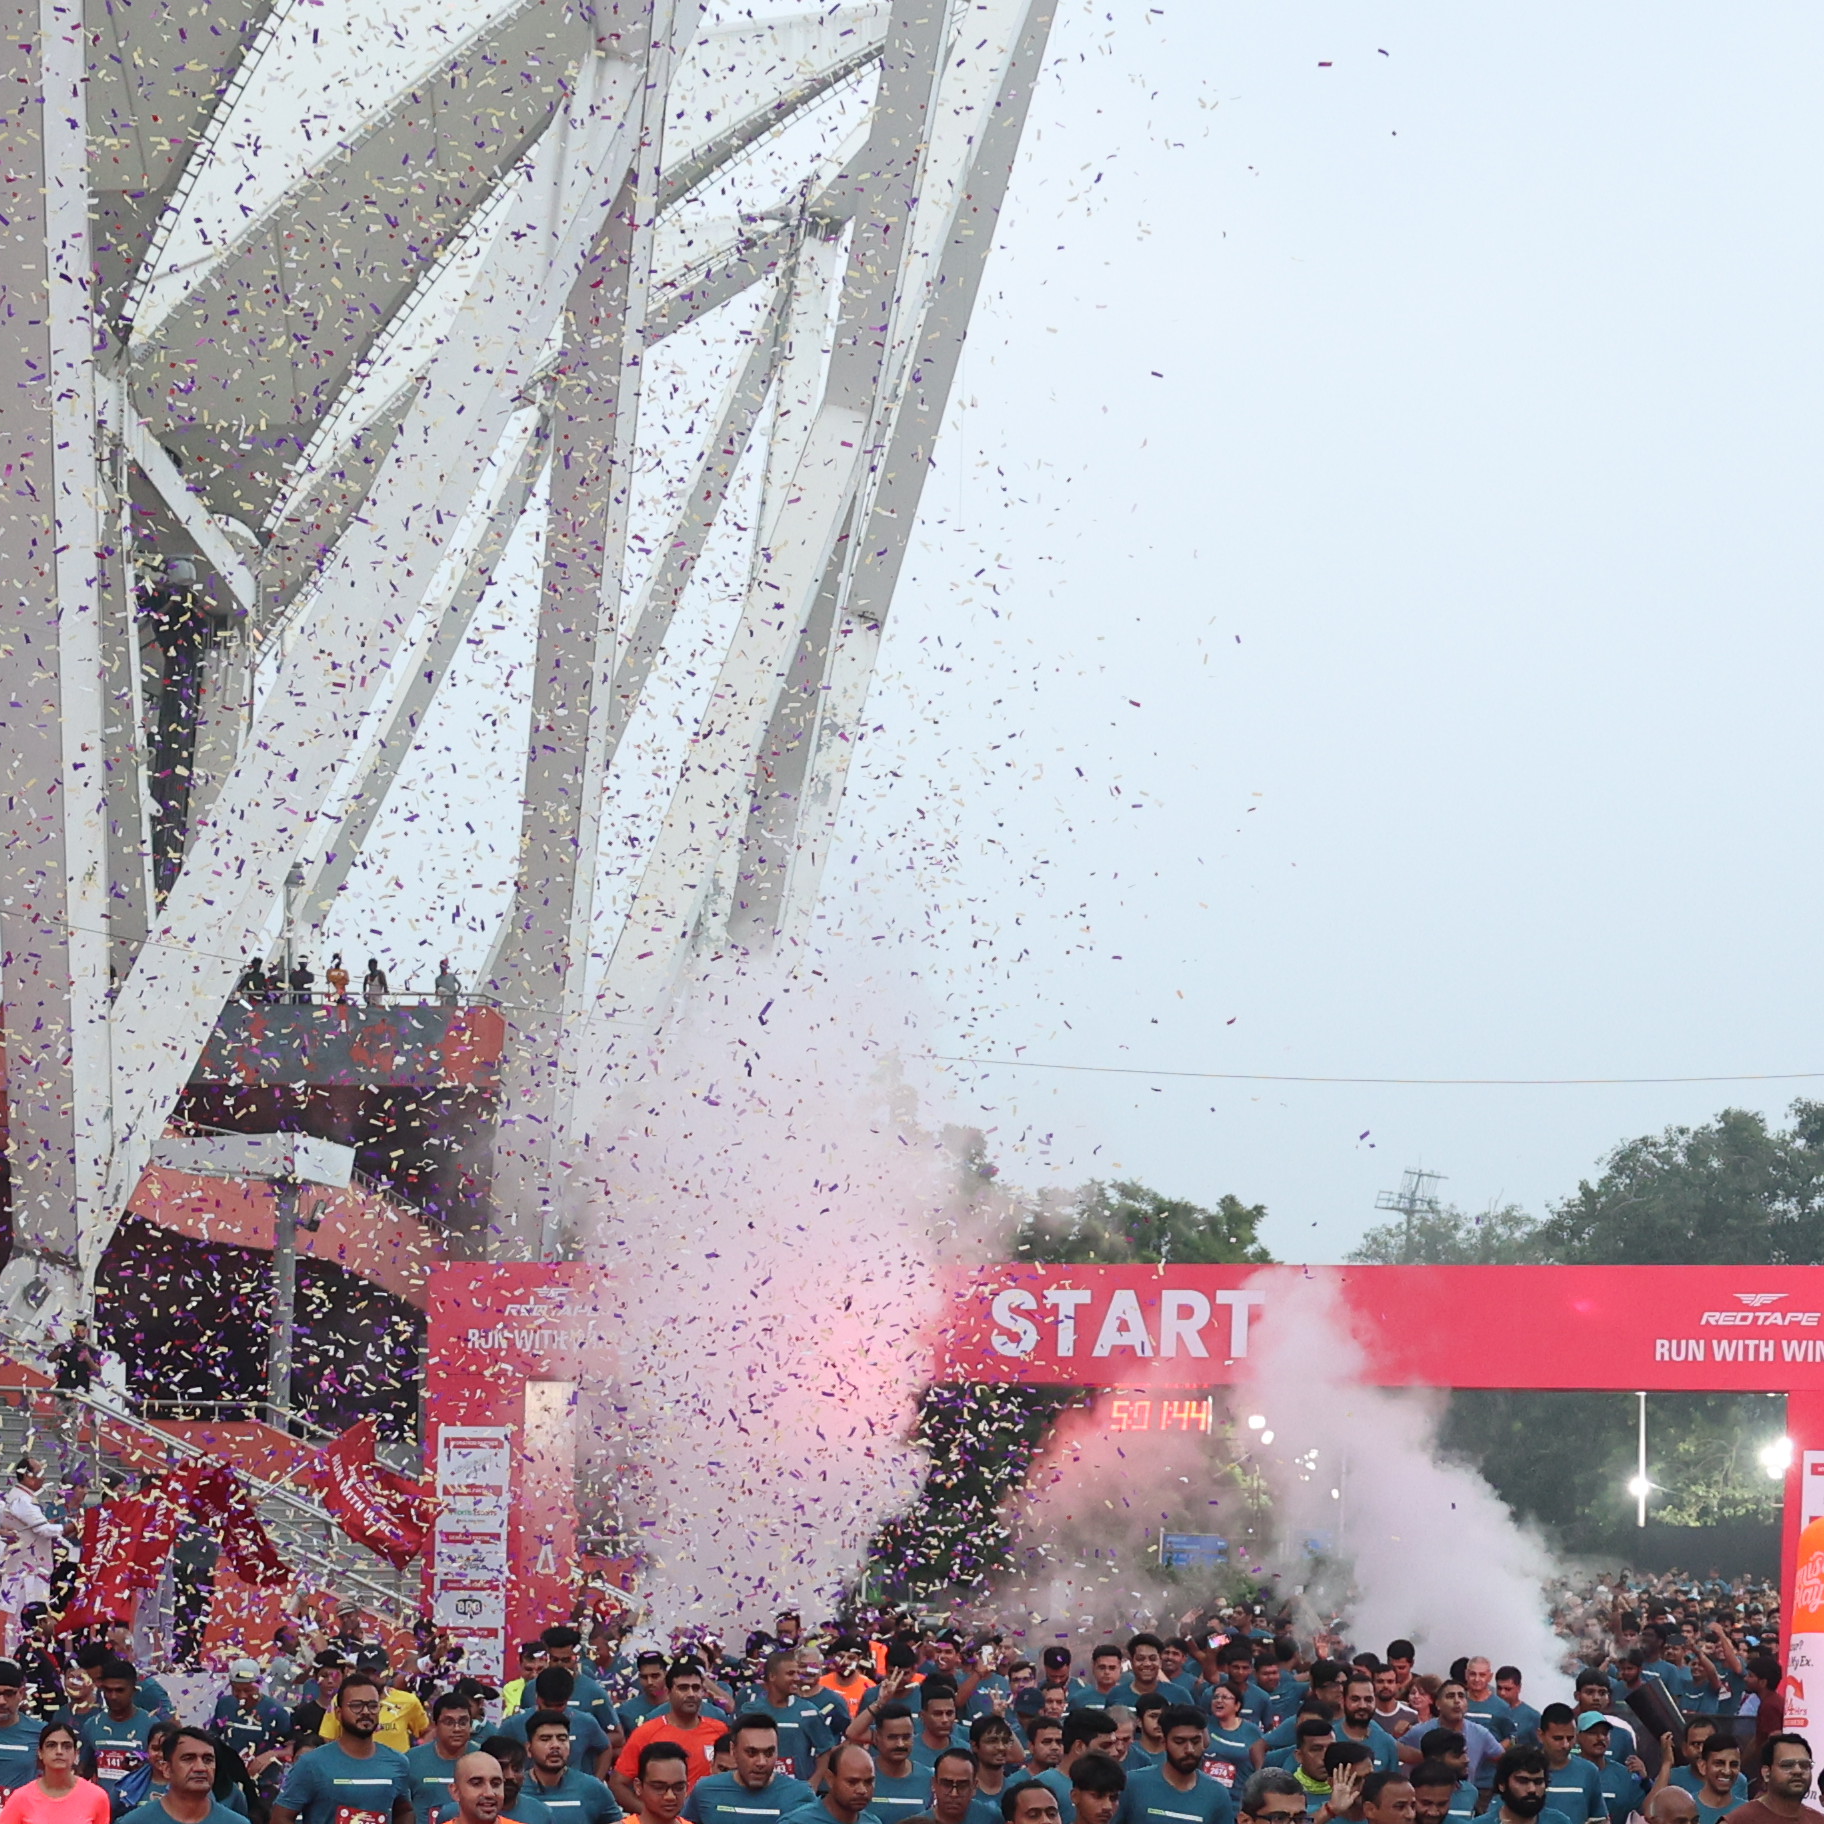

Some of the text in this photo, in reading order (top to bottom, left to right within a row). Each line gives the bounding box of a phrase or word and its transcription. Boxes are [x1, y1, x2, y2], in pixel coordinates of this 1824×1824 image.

[991, 1289, 1265, 1358] START
[1699, 1311, 1822, 1326] REDTAPE
[1654, 1338, 1706, 1362] RUN
[1712, 1339, 1775, 1362] WITH
